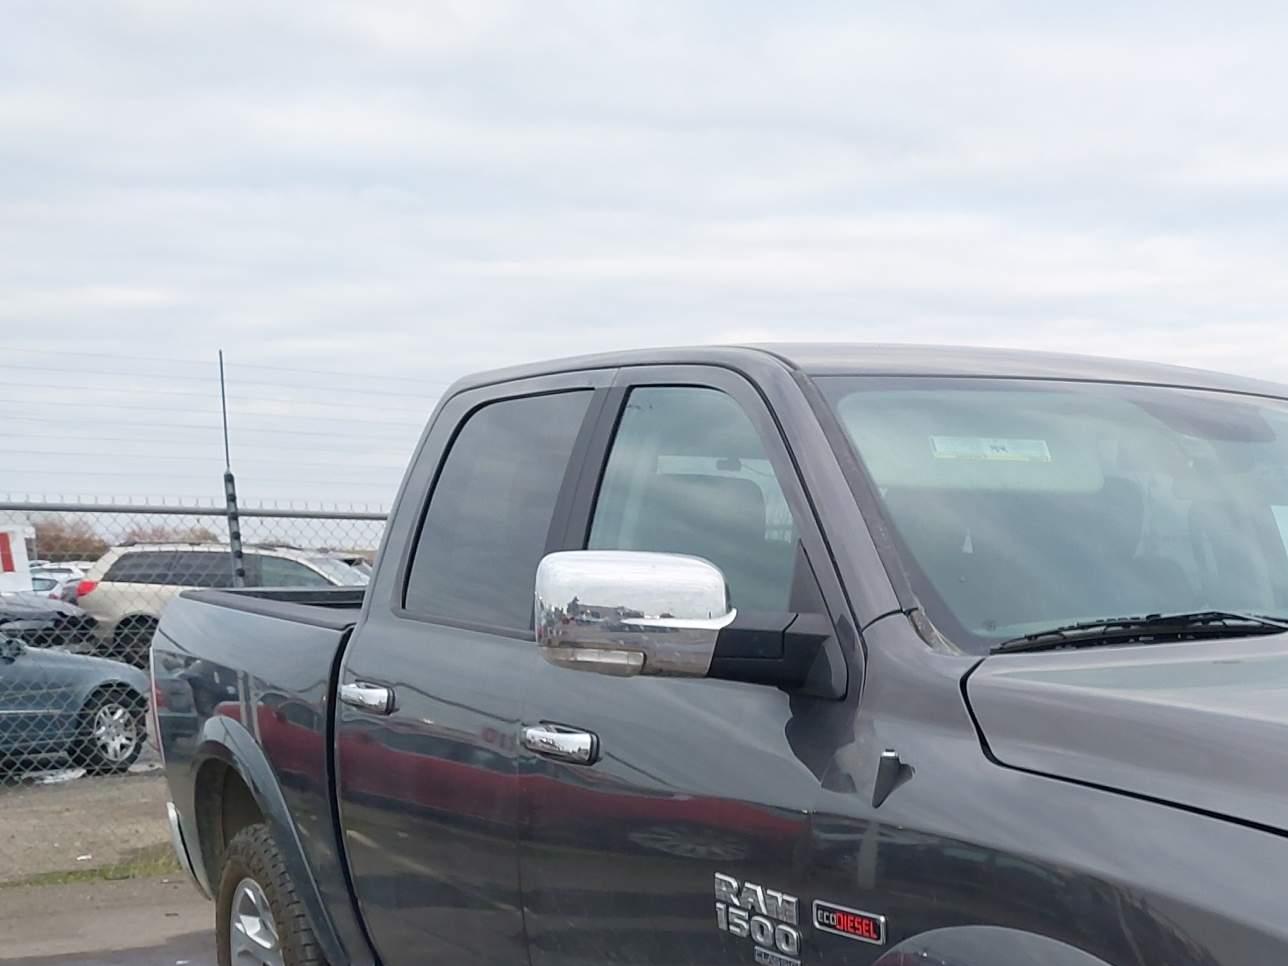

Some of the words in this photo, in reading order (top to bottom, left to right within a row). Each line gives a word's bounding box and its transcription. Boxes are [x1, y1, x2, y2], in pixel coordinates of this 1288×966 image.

[714, 872, 799, 925] RAM
[817, 909, 878, 939] ECODIESEL
[715, 902, 801, 956] 1500
